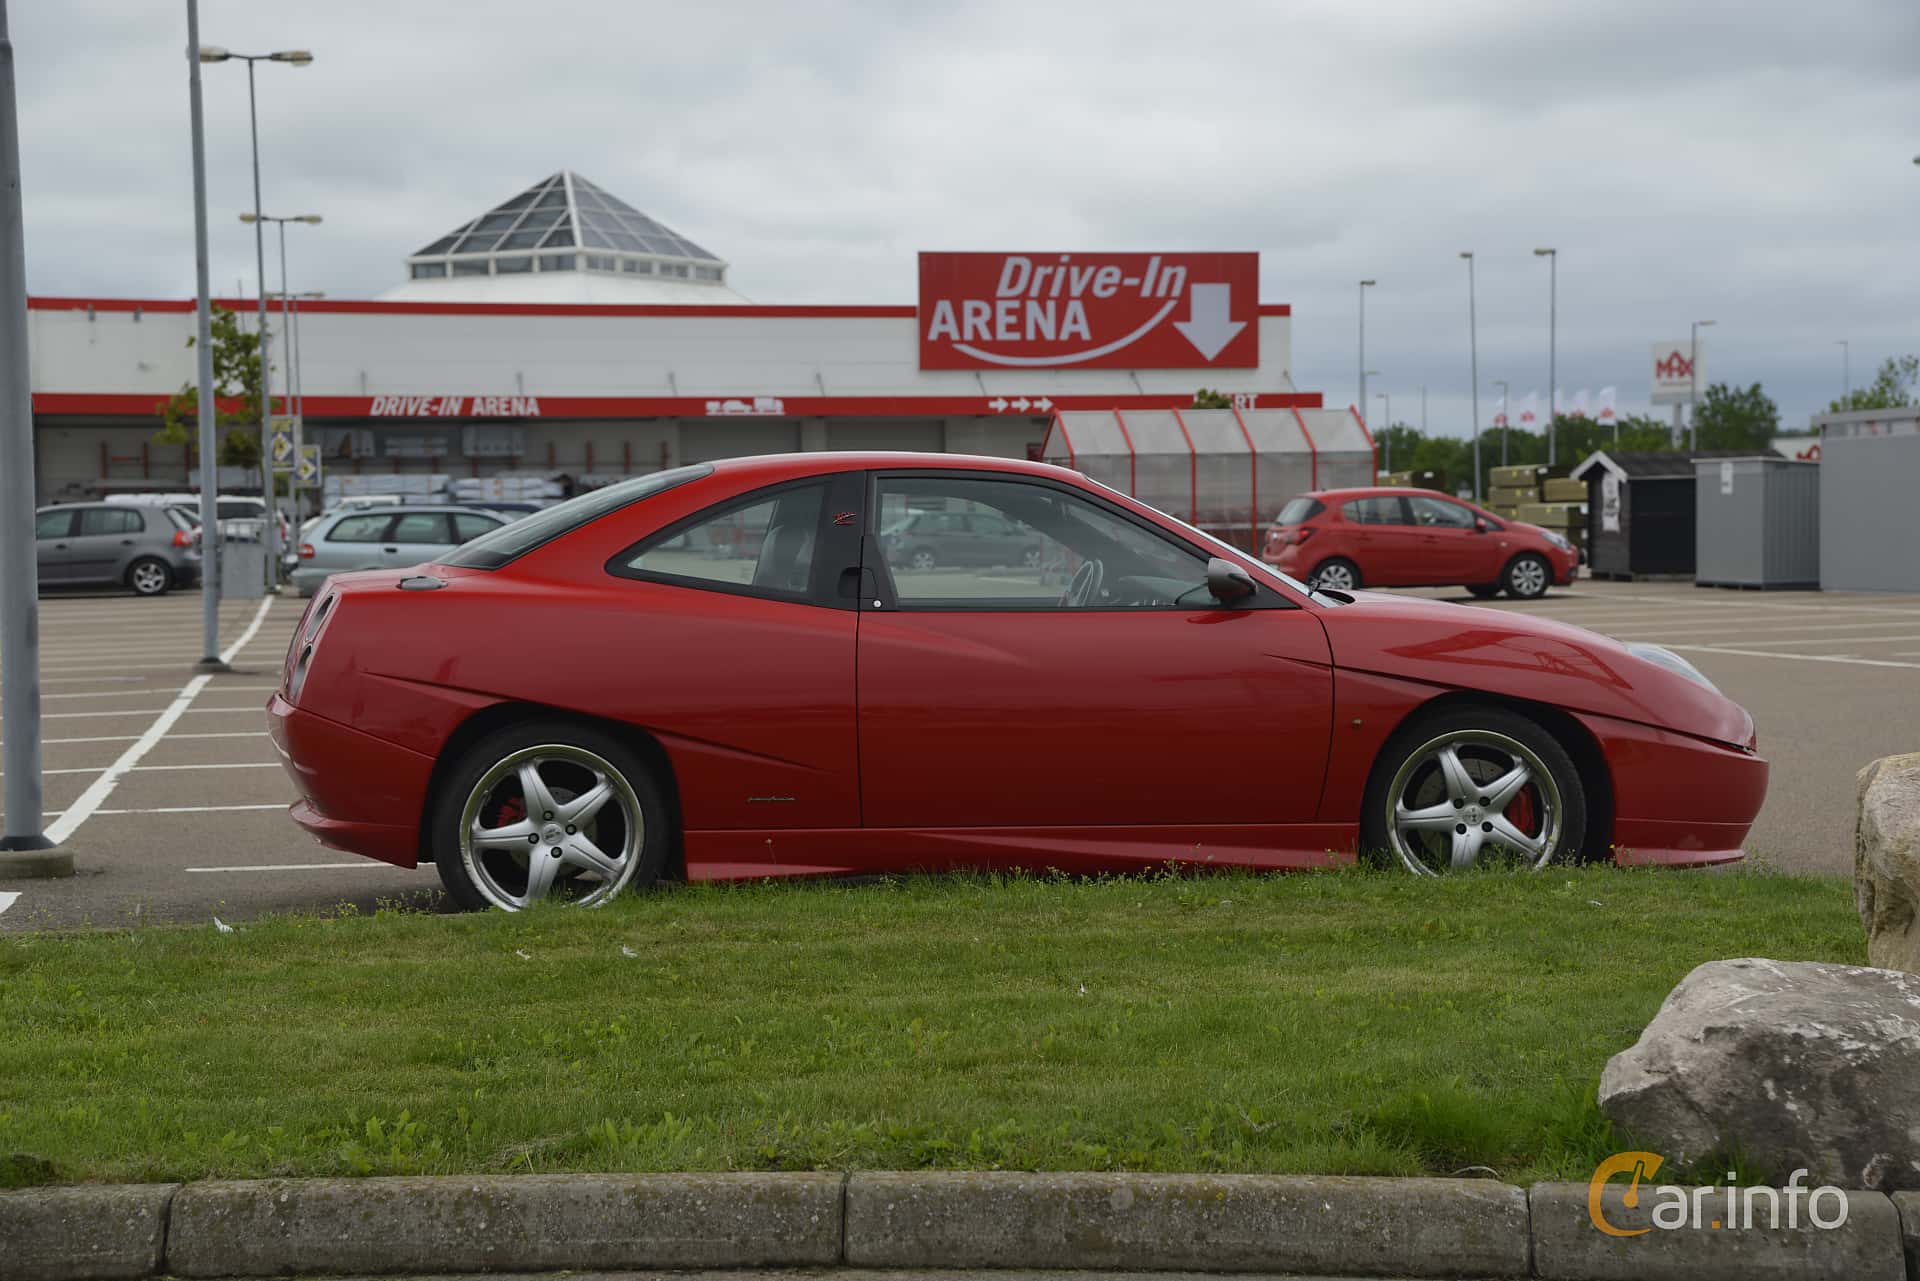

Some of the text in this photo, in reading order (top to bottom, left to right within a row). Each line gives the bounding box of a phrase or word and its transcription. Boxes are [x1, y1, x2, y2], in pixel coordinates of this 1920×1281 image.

[995, 255, 1188, 298] Drive-In
[927, 299, 1092, 341] ARENA
[1655, 350, 1695, 379] MAX
[370, 396, 541, 416] DRIVE-IN ARENA
